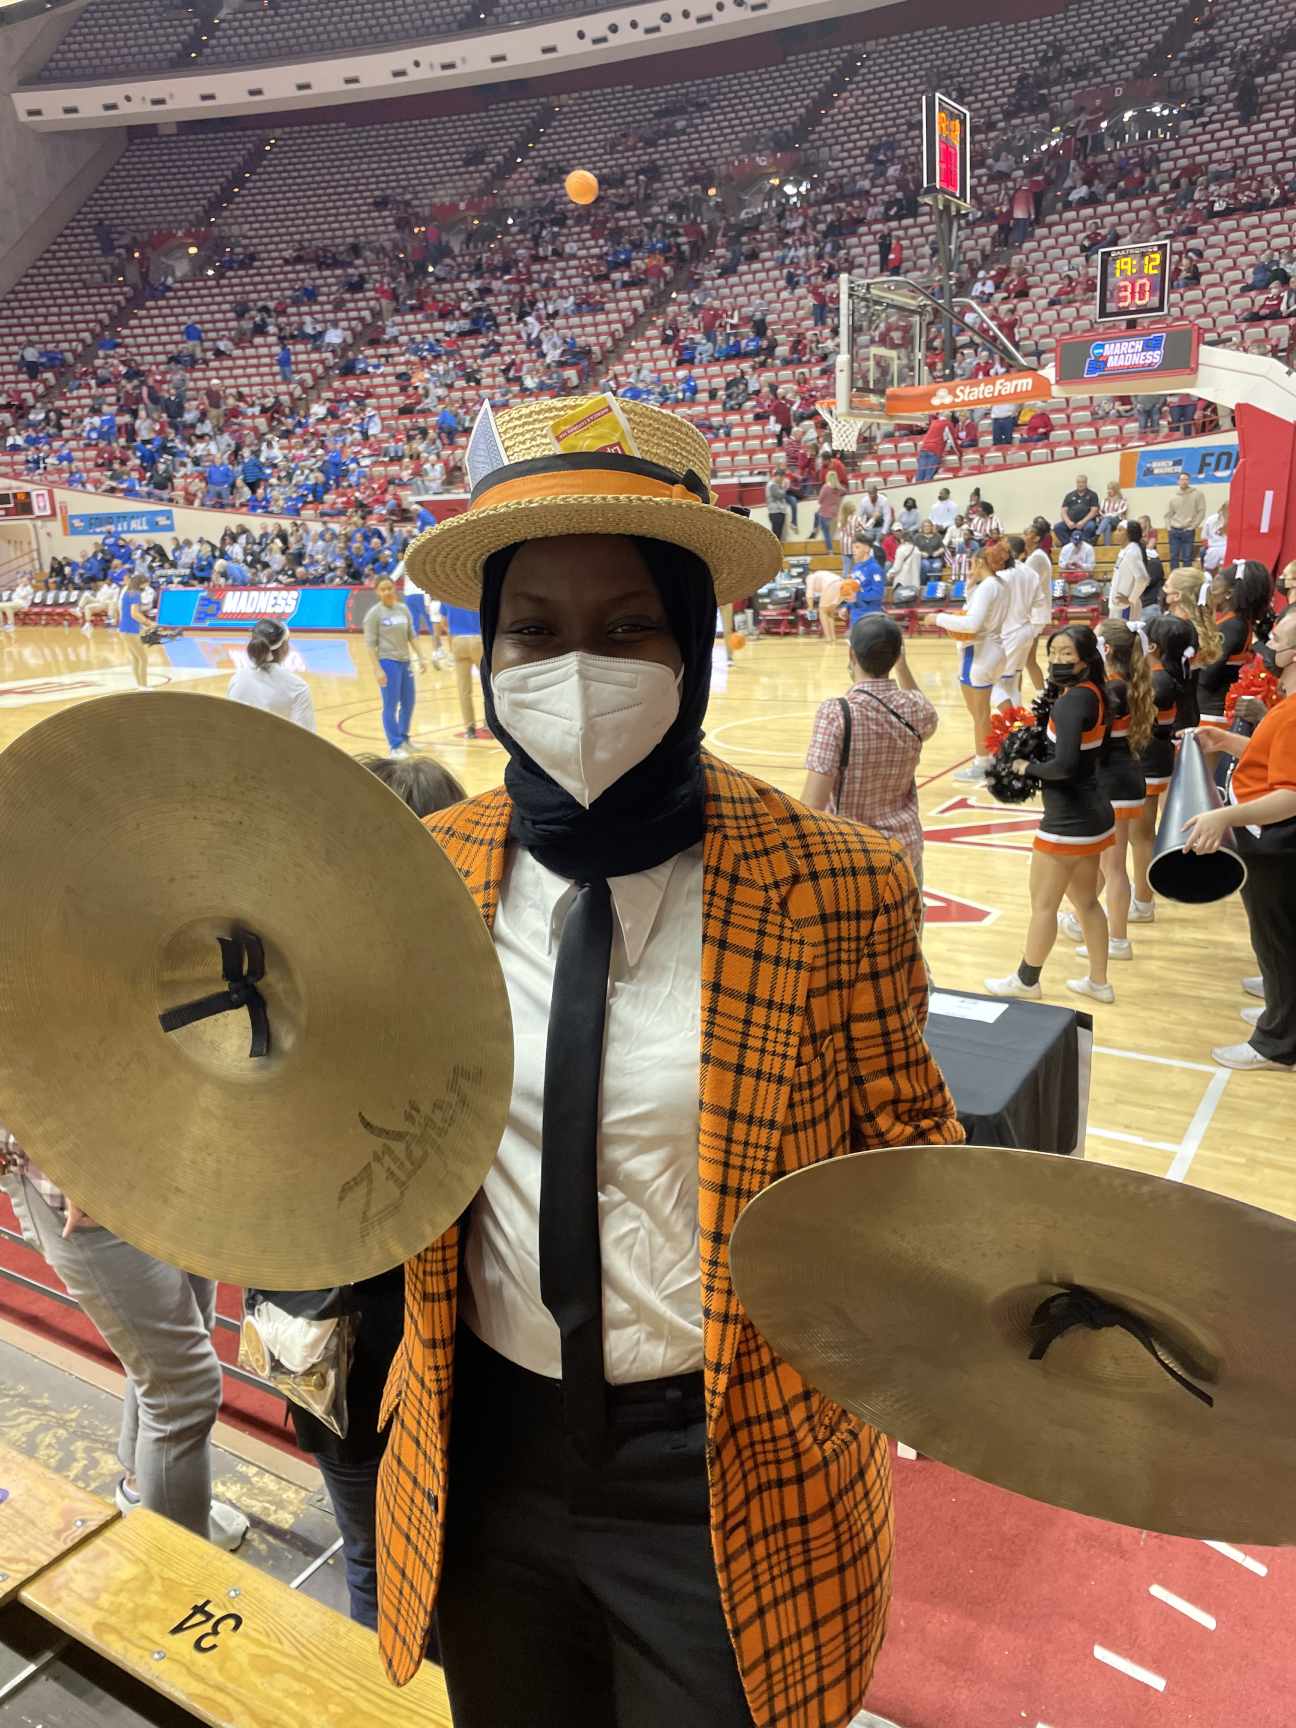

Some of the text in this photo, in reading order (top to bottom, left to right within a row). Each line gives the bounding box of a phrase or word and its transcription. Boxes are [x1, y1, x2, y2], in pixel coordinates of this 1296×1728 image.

[1115, 87, 1123, 97] D
[1117, 278, 1151, 308] 30
[1103, 340, 1144, 356] MARCH
[1106, 350, 1161, 368] MADNESS
[606, 445, 622, 454] Lip
[1197, 451, 1239, 478] FO
[129, 514, 149, 531] ALL
[222, 590, 299, 614] MADNESS
[168, 1599, 243, 1655] 34
